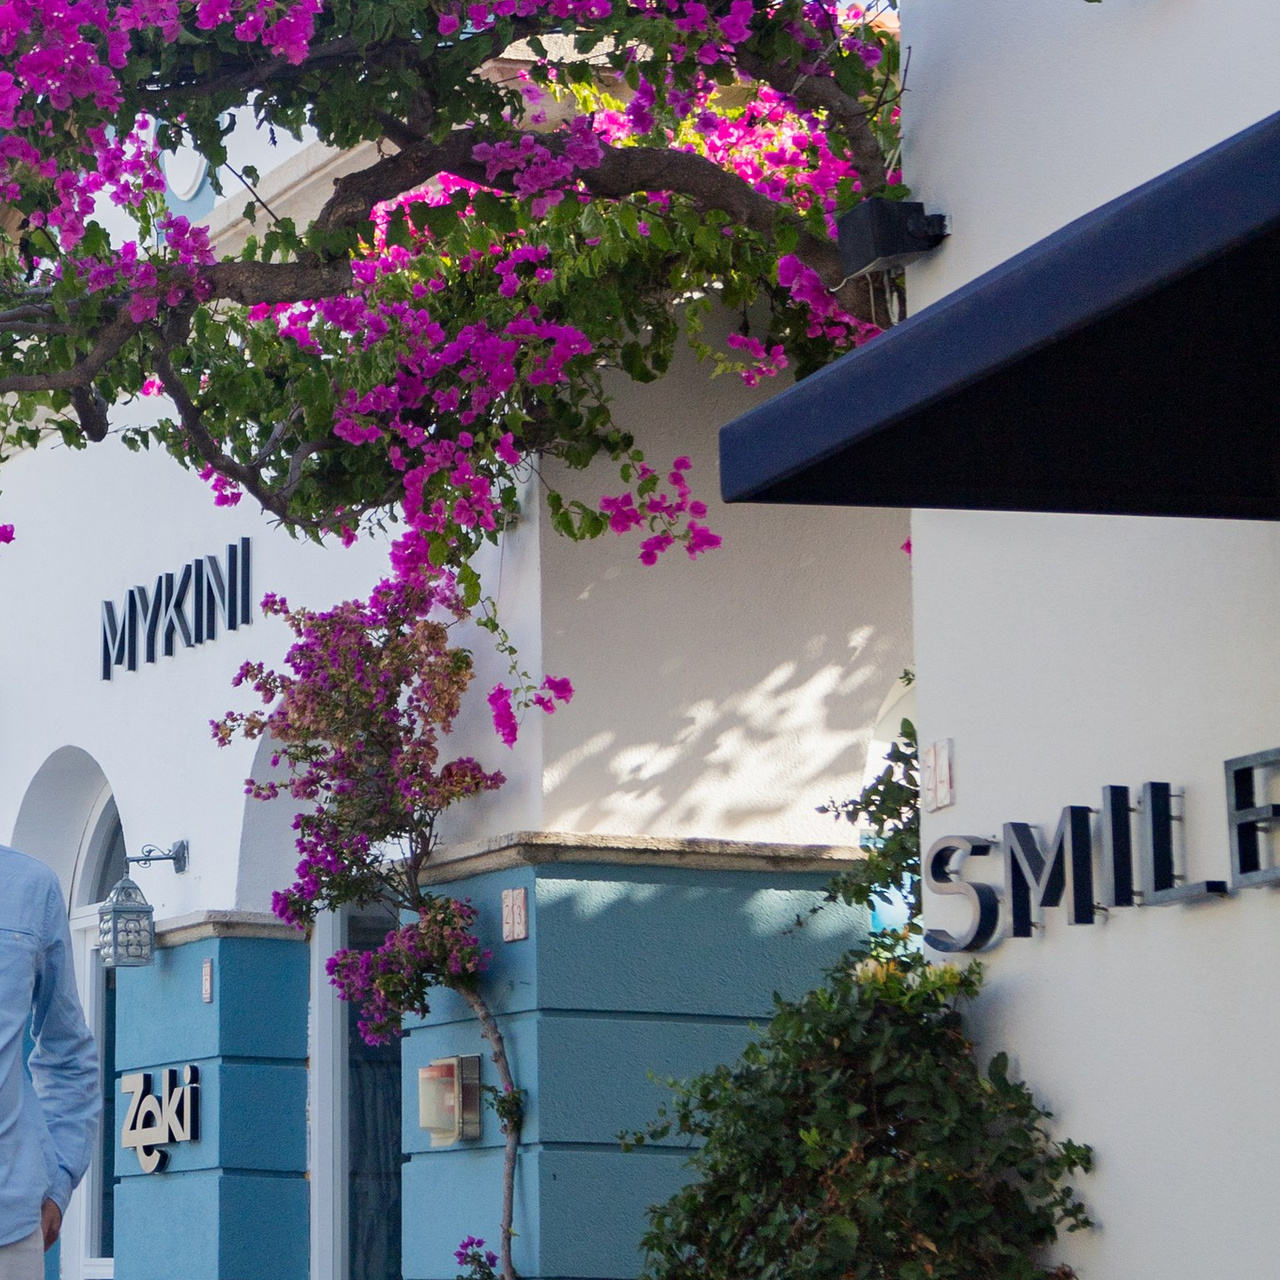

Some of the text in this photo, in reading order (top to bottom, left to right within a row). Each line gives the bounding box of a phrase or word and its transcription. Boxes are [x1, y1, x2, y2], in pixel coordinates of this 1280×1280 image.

[100, 536, 251, 681] MYKINI
[923, 747, 1280, 952] SMILE
[122, 1065, 200, 1174] Zeki
